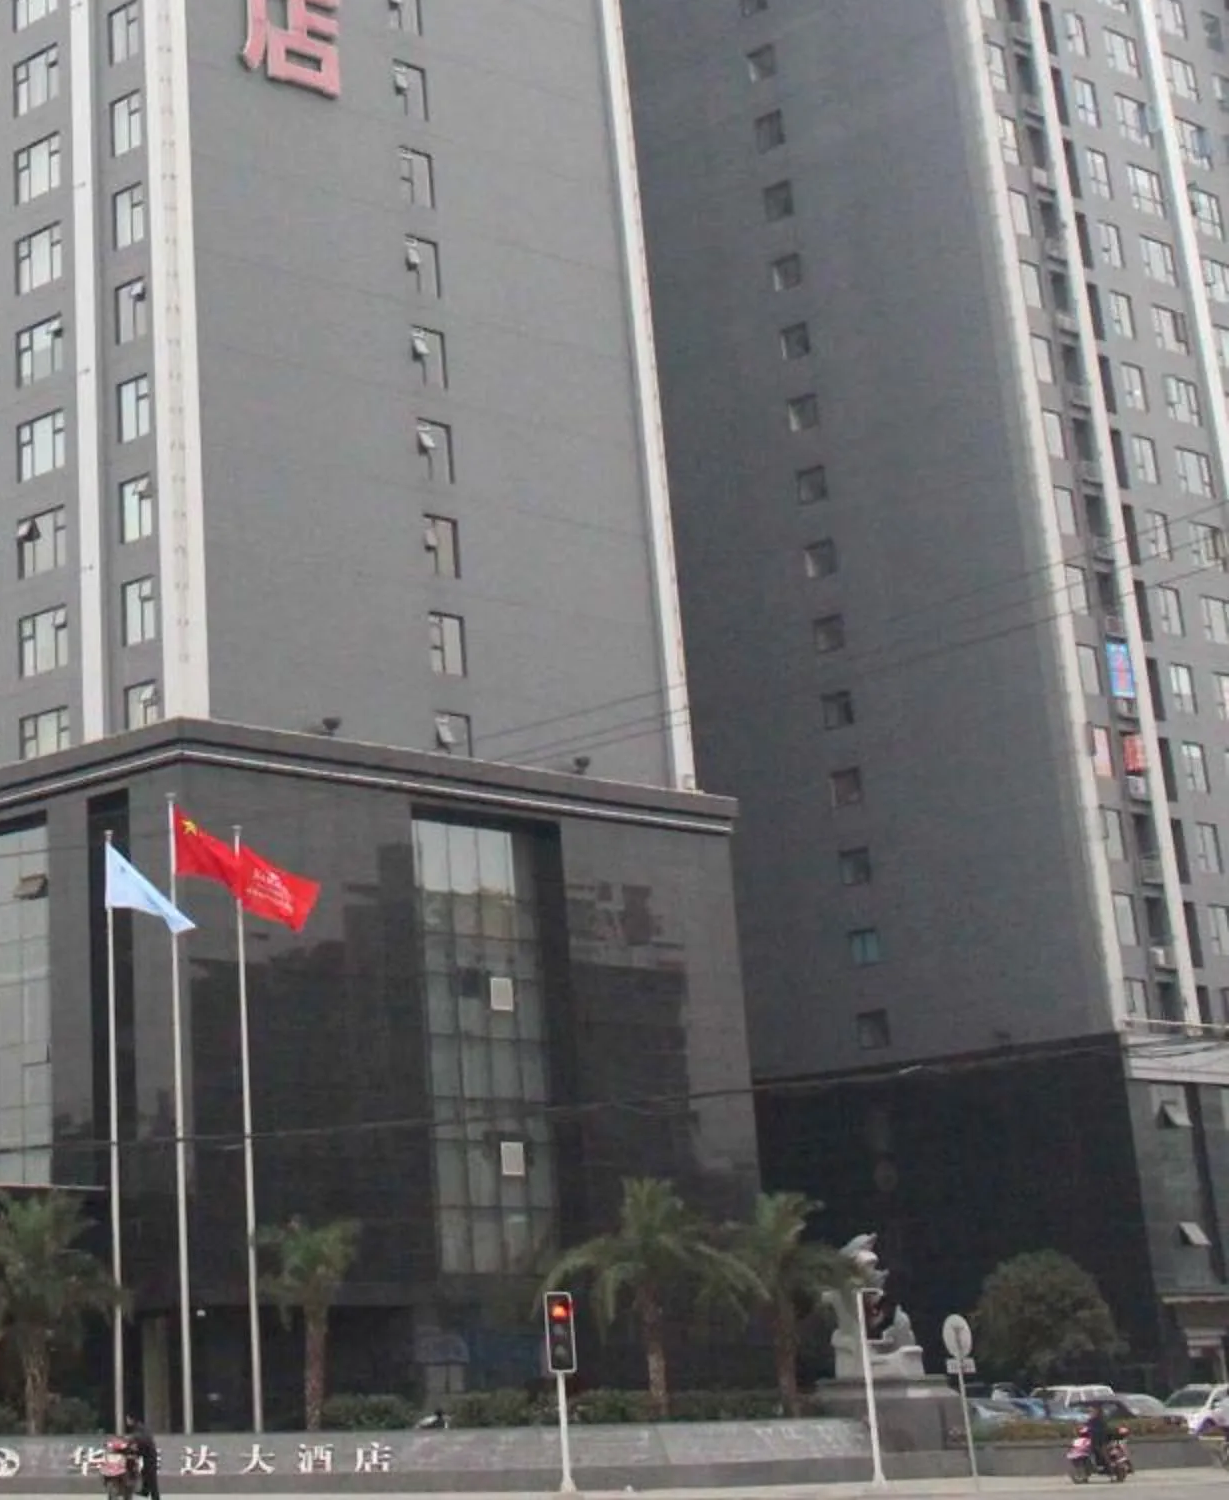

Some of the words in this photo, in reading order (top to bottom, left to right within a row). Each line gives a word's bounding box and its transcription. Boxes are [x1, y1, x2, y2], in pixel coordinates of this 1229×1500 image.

[69, 1443, 393, 1476] 华达大酒店
